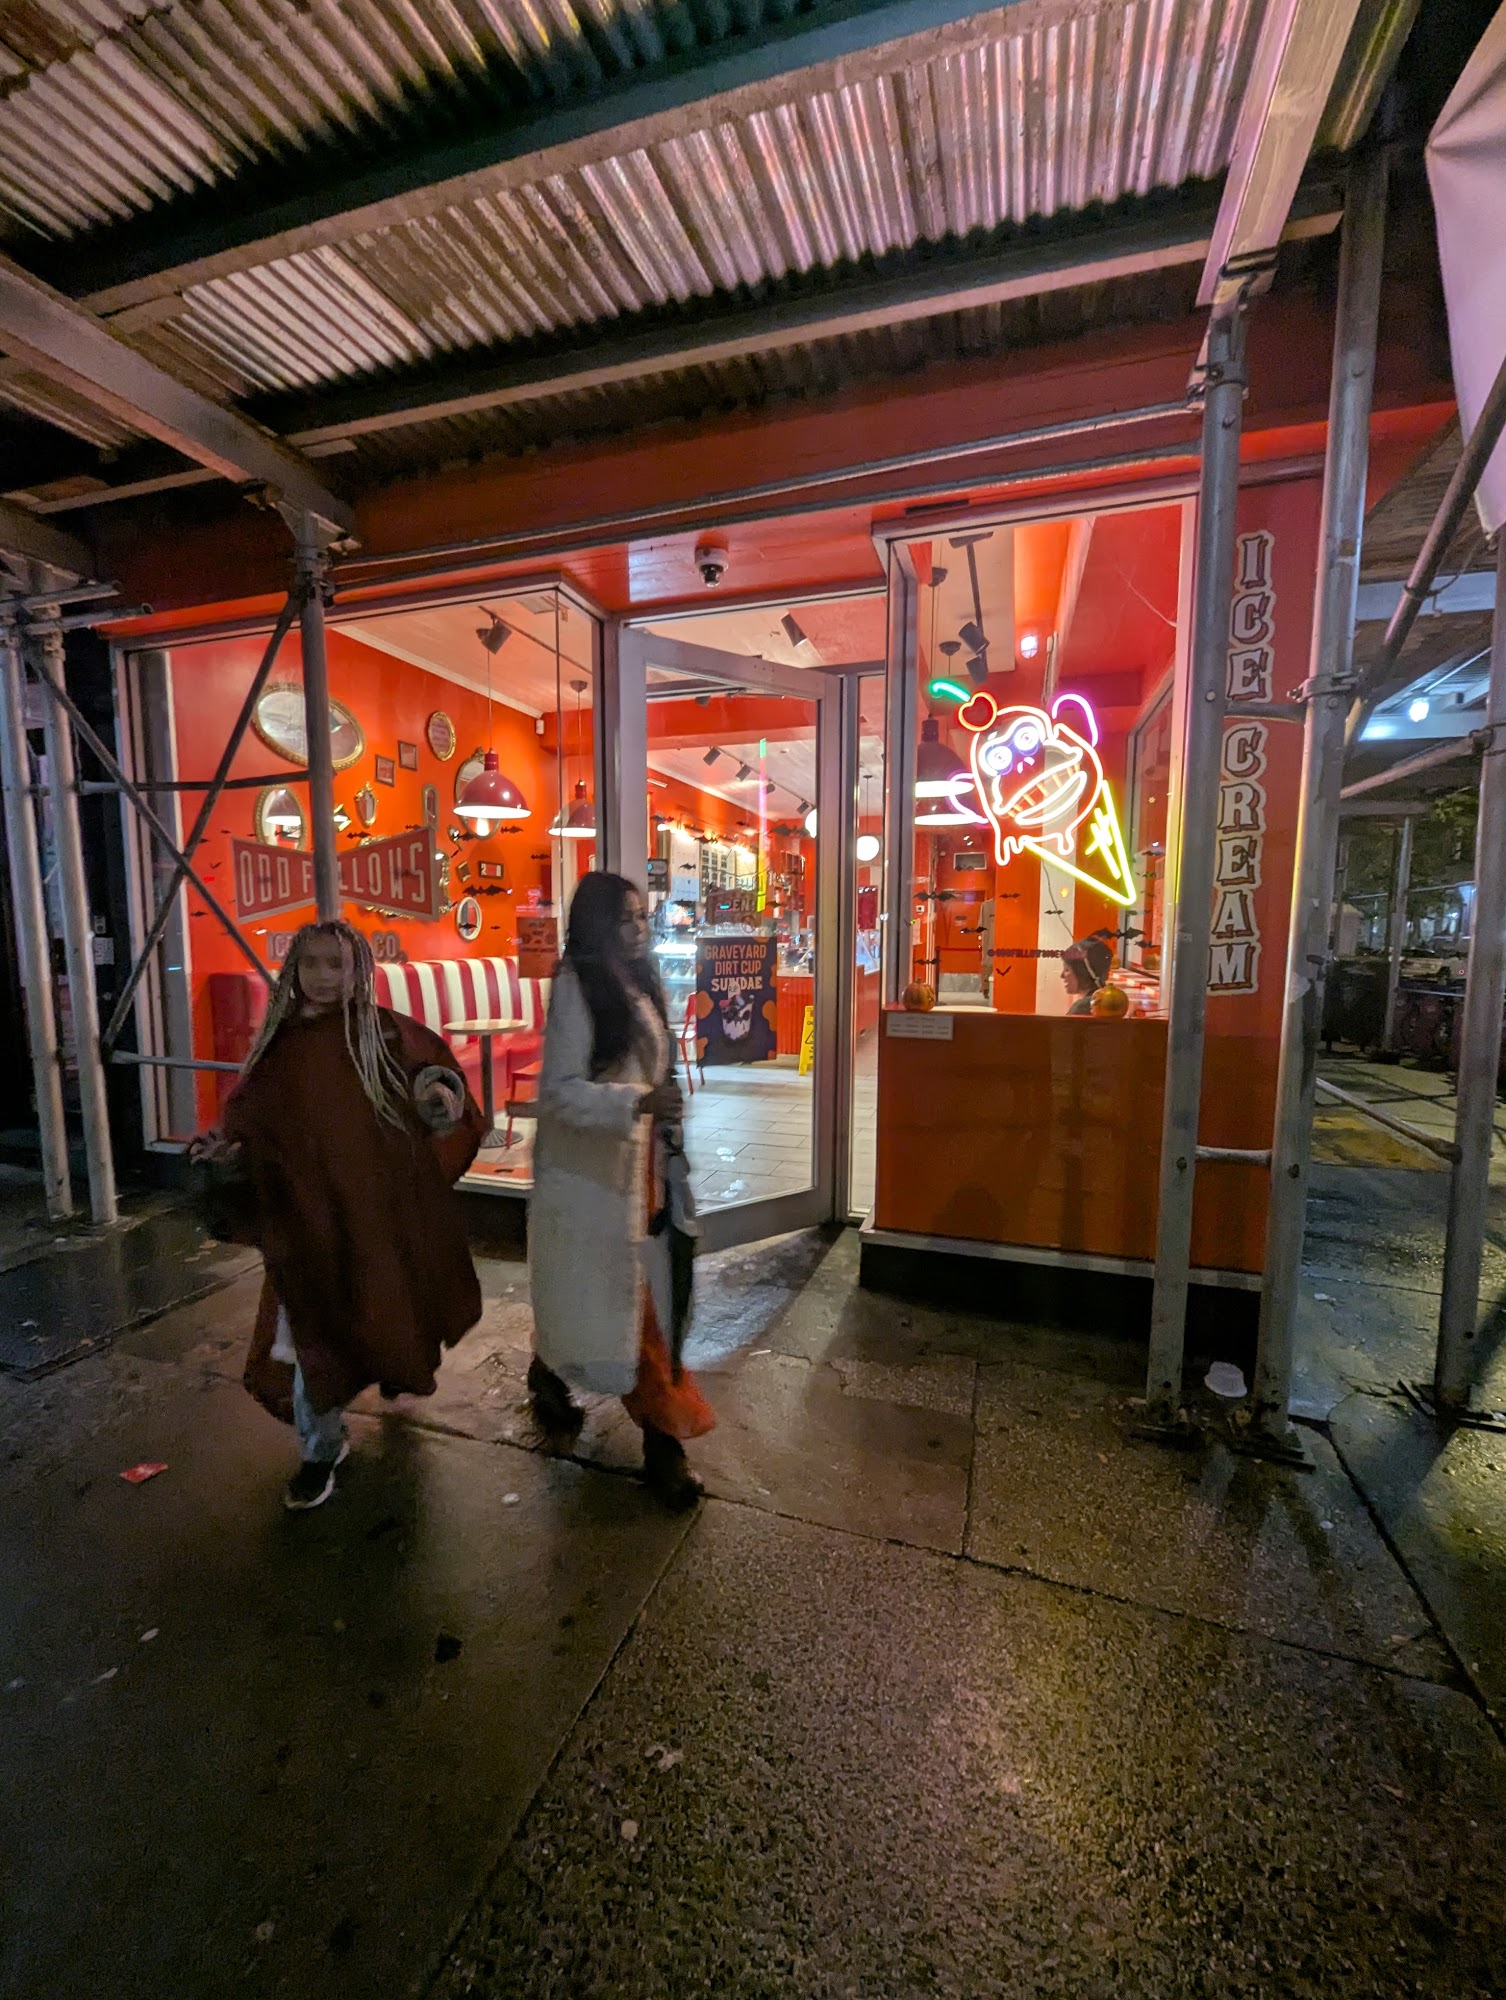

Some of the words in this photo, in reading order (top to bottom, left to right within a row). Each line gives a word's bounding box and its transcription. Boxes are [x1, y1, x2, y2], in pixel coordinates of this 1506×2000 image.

[1228, 532, 1273, 702] ICE
[240, 850, 291, 906] ODD
[302, 842, 426, 904] FLLOWS
[1207, 722, 1267, 993] CREAM
[704, 944, 767, 960] GRAVEYARD
[715, 961, 739, 976] DIRT
[741, 960, 761, 974] CUP
[711, 976, 763, 992] SUNDAE
